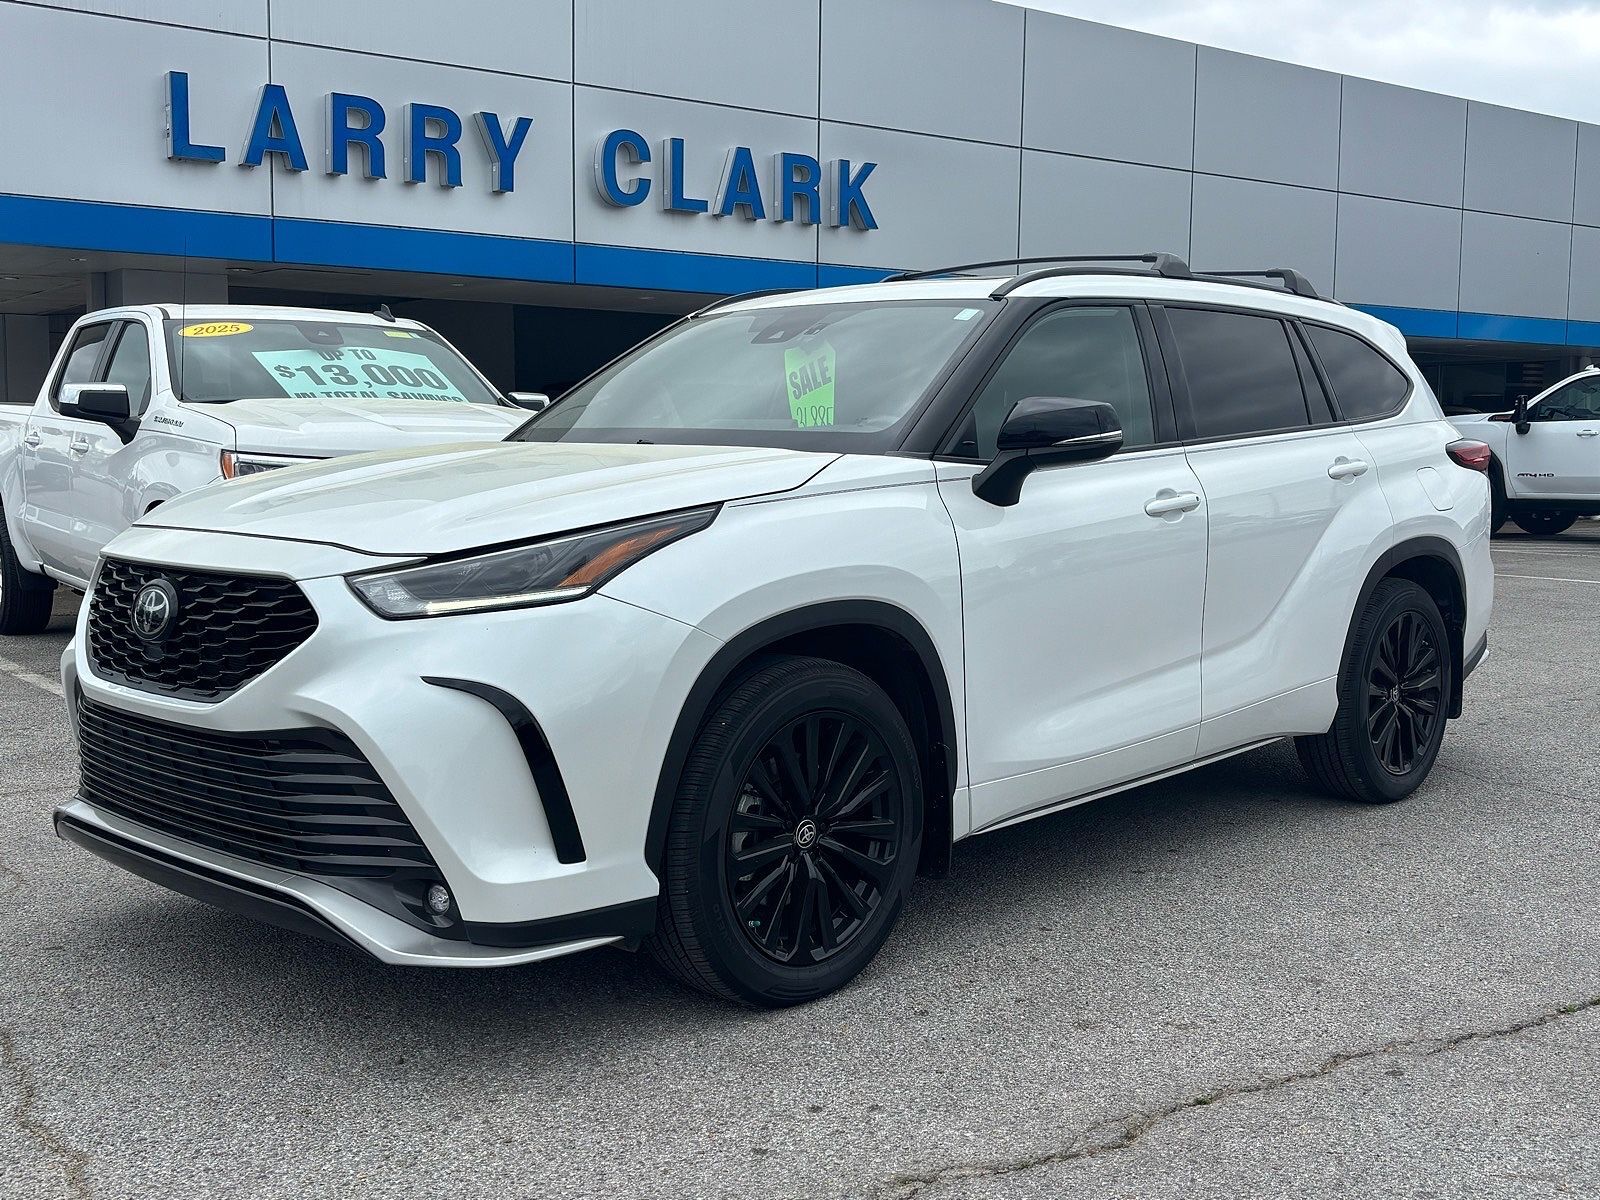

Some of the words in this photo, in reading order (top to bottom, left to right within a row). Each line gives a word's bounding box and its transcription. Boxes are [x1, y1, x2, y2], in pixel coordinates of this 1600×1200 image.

[165, 71, 533, 194] LARRY
[594, 128, 879, 231] CLARK
[193, 324, 241, 336] 2025
[317, 349, 345, 362] UP
[347, 348, 377, 361] TO
[273, 363, 449, 391] $13,000
[788, 355, 833, 401] SALE
